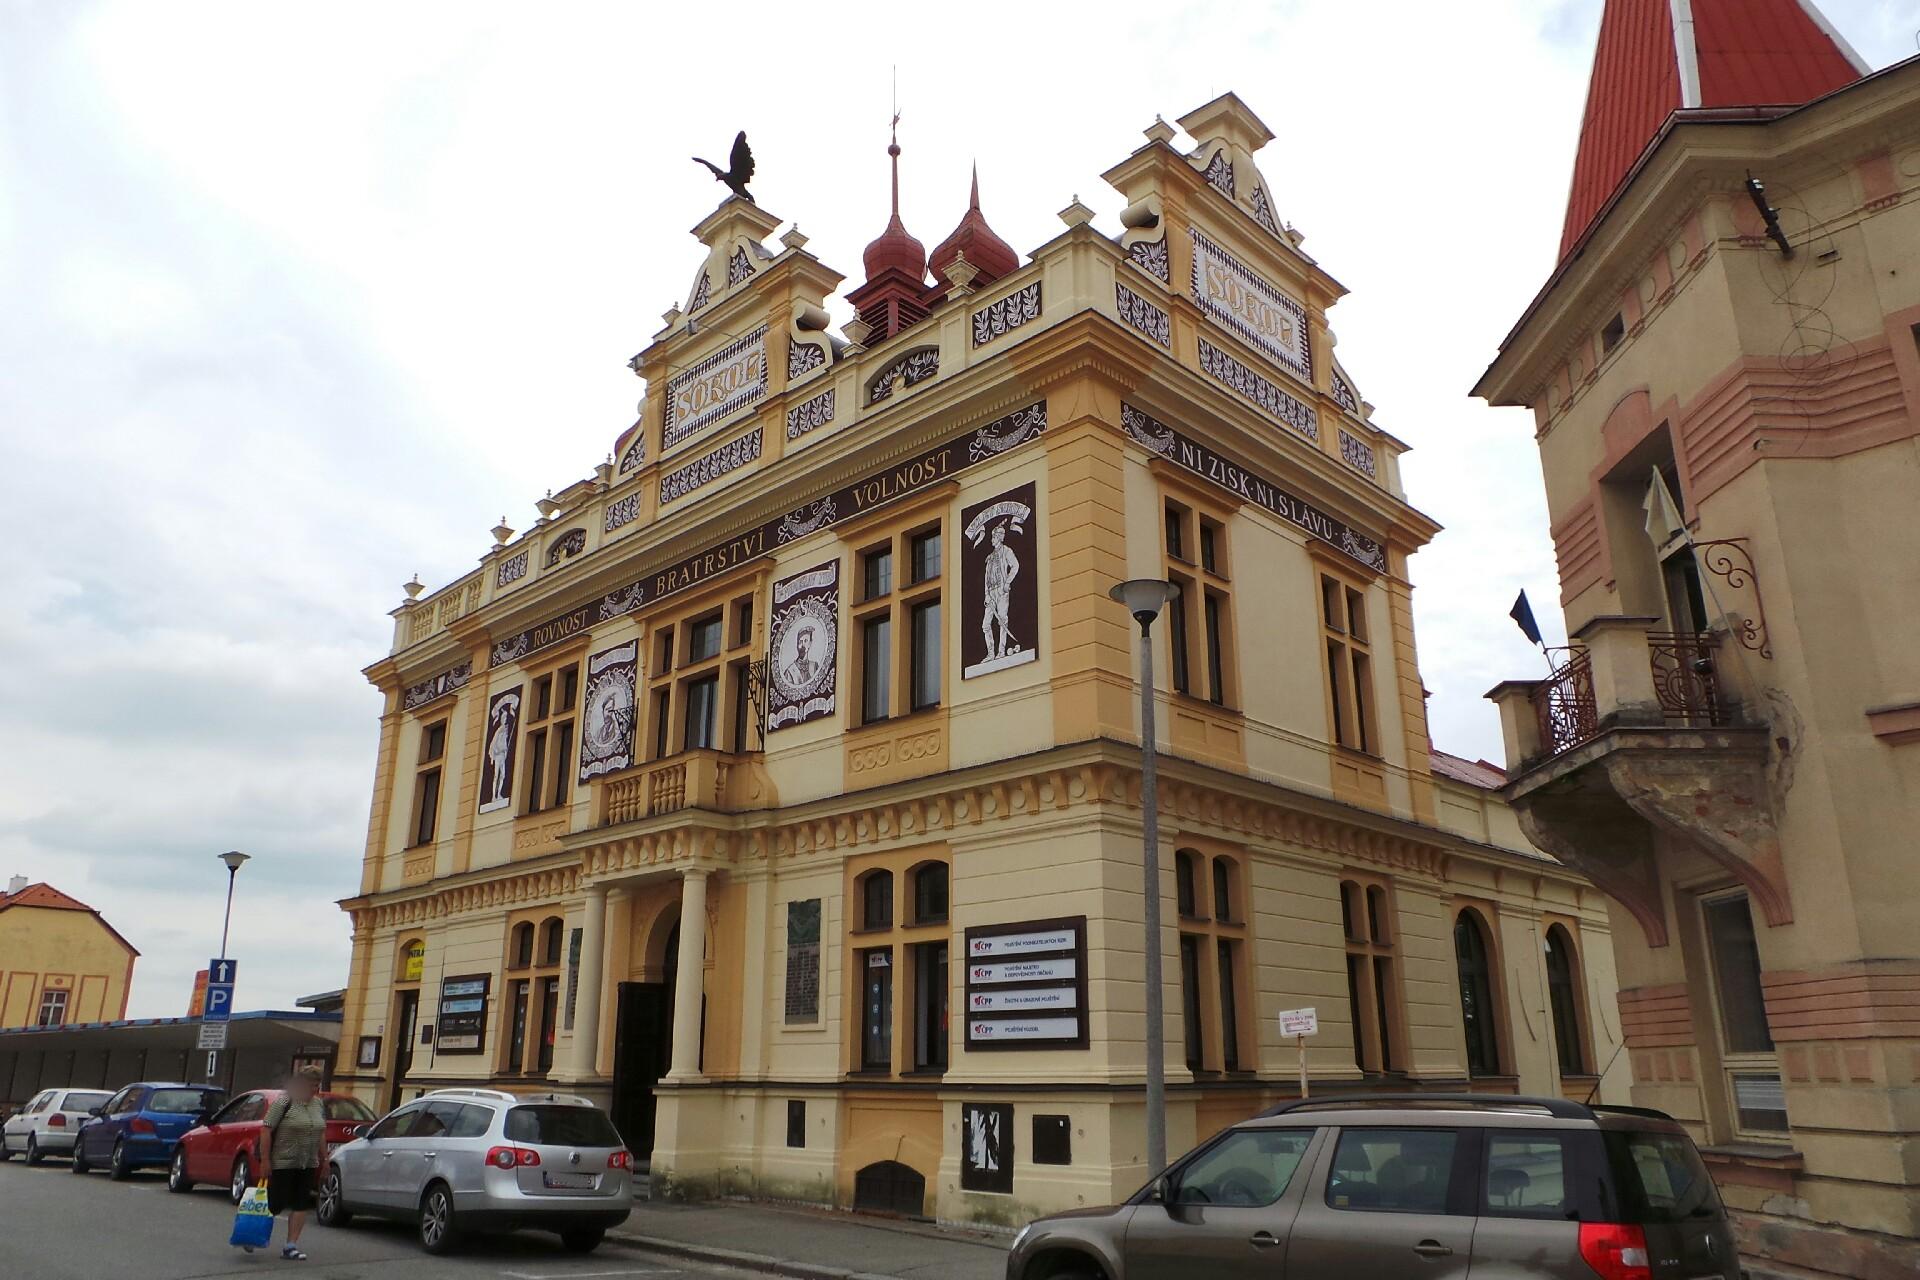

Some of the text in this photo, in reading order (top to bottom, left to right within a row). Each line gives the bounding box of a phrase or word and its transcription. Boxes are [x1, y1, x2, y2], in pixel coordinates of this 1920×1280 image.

[1207, 264, 1294, 351] SOKOL
[676, 350, 761, 424] SOKOL
[852, 448, 952, 509] VOLNOST
[655, 531, 766, 596] BRATRSTVÍ
[533, 608, 589, 647] ROVNOST
[210, 990, 227, 1011] P
[239, 1200, 268, 1212] alber
